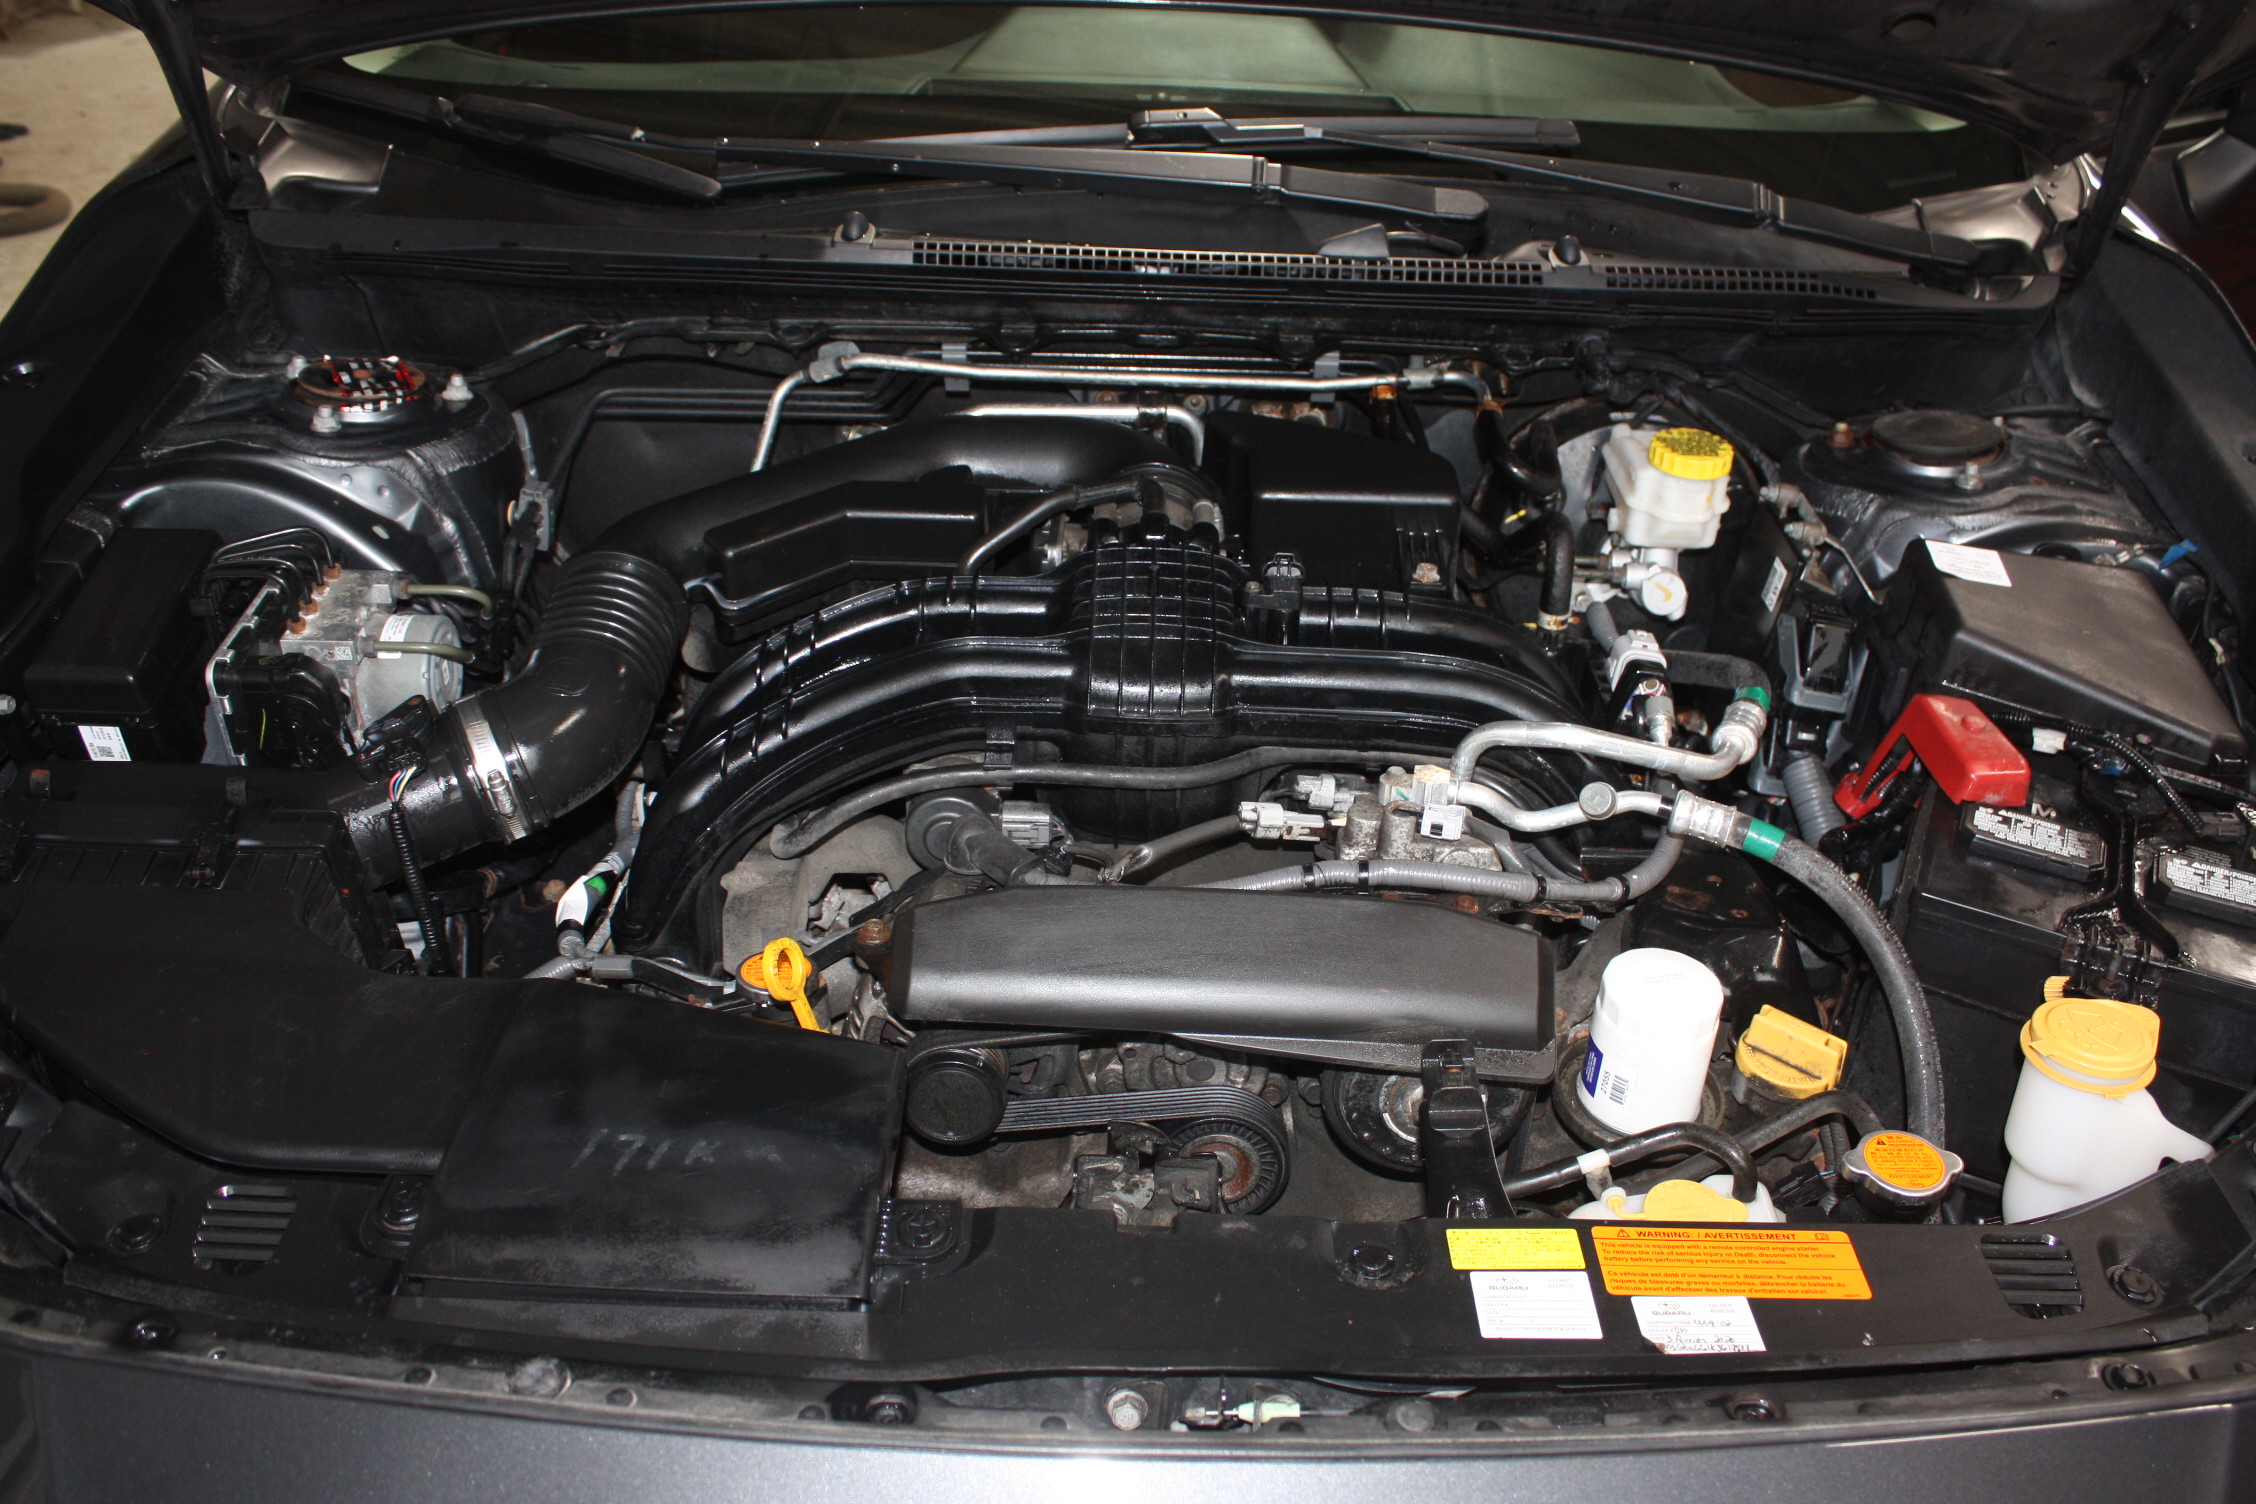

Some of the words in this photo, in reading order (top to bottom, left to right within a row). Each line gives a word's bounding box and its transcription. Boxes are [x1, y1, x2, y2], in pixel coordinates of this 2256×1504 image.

[2007, 811, 2061, 831] DANGER/POISON
[1600, 1070, 1611, 1094] 27055
[1636, 1230, 1694, 1238] WARNING:
[1704, 1232, 1796, 1240] AVERTISSEMENT
